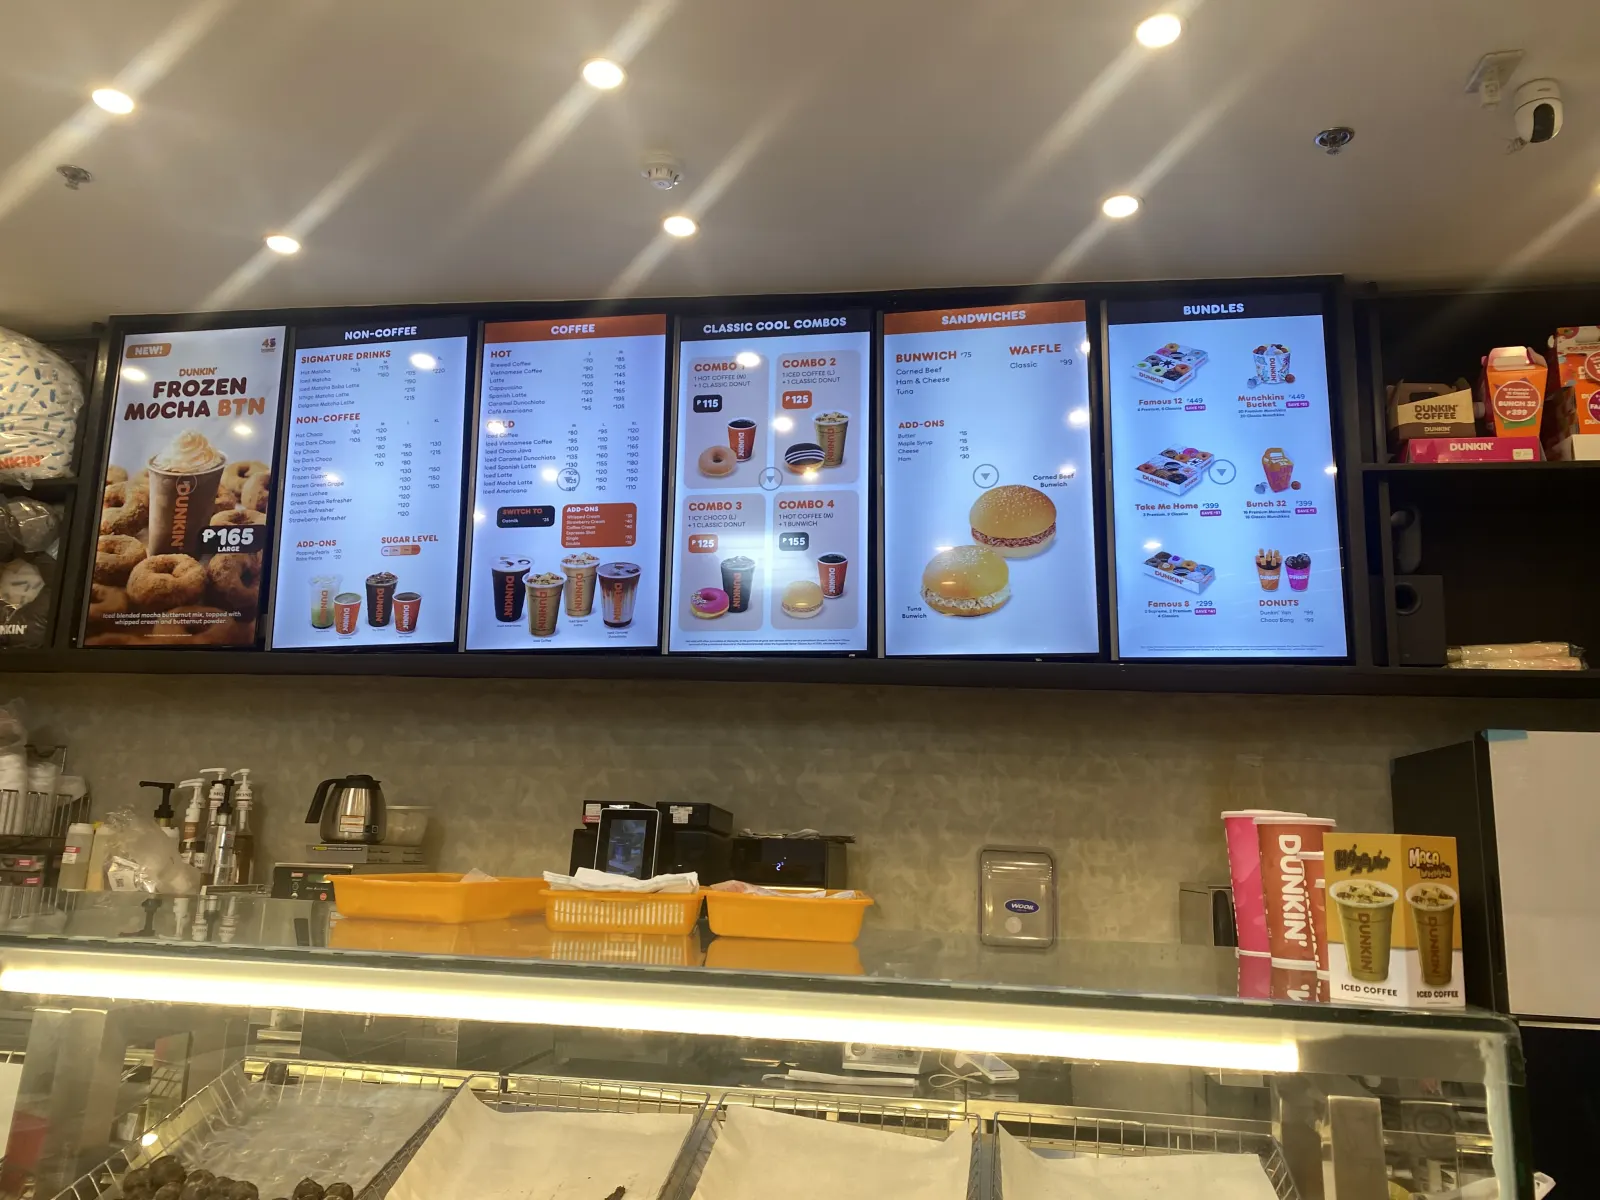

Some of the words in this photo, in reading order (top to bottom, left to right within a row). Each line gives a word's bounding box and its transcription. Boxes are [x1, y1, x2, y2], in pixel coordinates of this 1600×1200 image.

[1183, 303, 1245, 315] BUNDLES
[941, 310, 1027, 325] SANDWICHES
[551, 324, 596, 335] COFFEE
[703, 322, 753, 334] CLASSIC
[755, 320, 791, 331] COOL
[793, 317, 847, 329] COMBOS
[344, 326, 418, 341] NON-COFFEE
[135, 346, 163, 356] NEW!
[490, 350, 512, 358] HOT
[1009, 343, 1062, 356] WAFFLE
[301, 351, 354, 364] SIGNATURE
[356, 350, 391, 360] DRINKS
[895, 350, 957, 364] BUNWICH
[694, 362, 737, 372] COMBO
[782, 358, 827, 368] COMBO
[829, 357, 836, 366] 2
[1009, 361, 1038, 369] Classic
[179, 367, 217, 377] DUNKIN'
[896, 368, 923, 376] Corned
[922, 376, 950, 384] Cheese
[153, 377, 247, 399] FROZEN
[124, 400, 211, 421] MOCHA
[217, 397, 265, 417] BTN
[1414, 404, 1459, 413] DUNKIN'
[296, 413, 361, 424] NON-COFFEE
[1414, 412, 1457, 420] COFFEE
[898, 420, 945, 429] ADD-ONS
[1450, 442, 1494, 451] DUNKIN'
[1033, 473, 1057, 481] Corned
[688, 502, 733, 512] COMBO
[735, 502, 743, 510] 3
[778, 500, 824, 510] COMBO
[826, 500, 835, 508] 4
[296, 539, 337, 548] ADD-ONS
[381, 536, 410, 544] SUGAR
[1259, 599, 1299, 607] DONUTS
[1278, 834, 1309, 947] DUNKIN'
[1356, 912, 1373, 972] DUNKIN'
[1340, 983, 1361, 993] ICED
[1363, 986, 1398, 997] COFFEE
[1416, 990, 1433, 998] ICED
[1433, 990, 1459, 998] COFFEE
